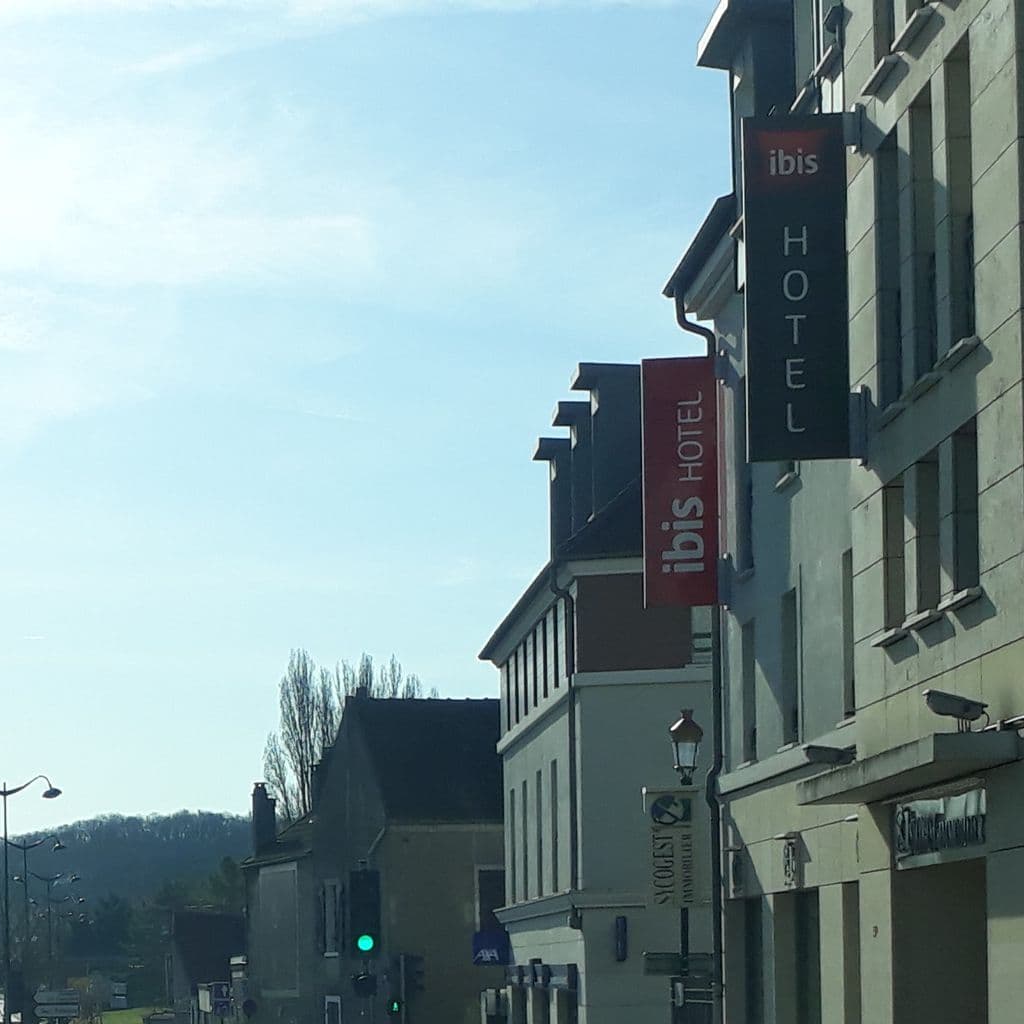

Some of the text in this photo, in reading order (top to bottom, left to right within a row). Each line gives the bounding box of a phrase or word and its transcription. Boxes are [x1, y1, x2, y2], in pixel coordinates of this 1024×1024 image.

[768, 149, 819, 176] ibis
[783, 226, 809, 433] HOTEL
[661, 390, 705, 575] ibis HOTEL
[473, 948, 500, 962] AXA
